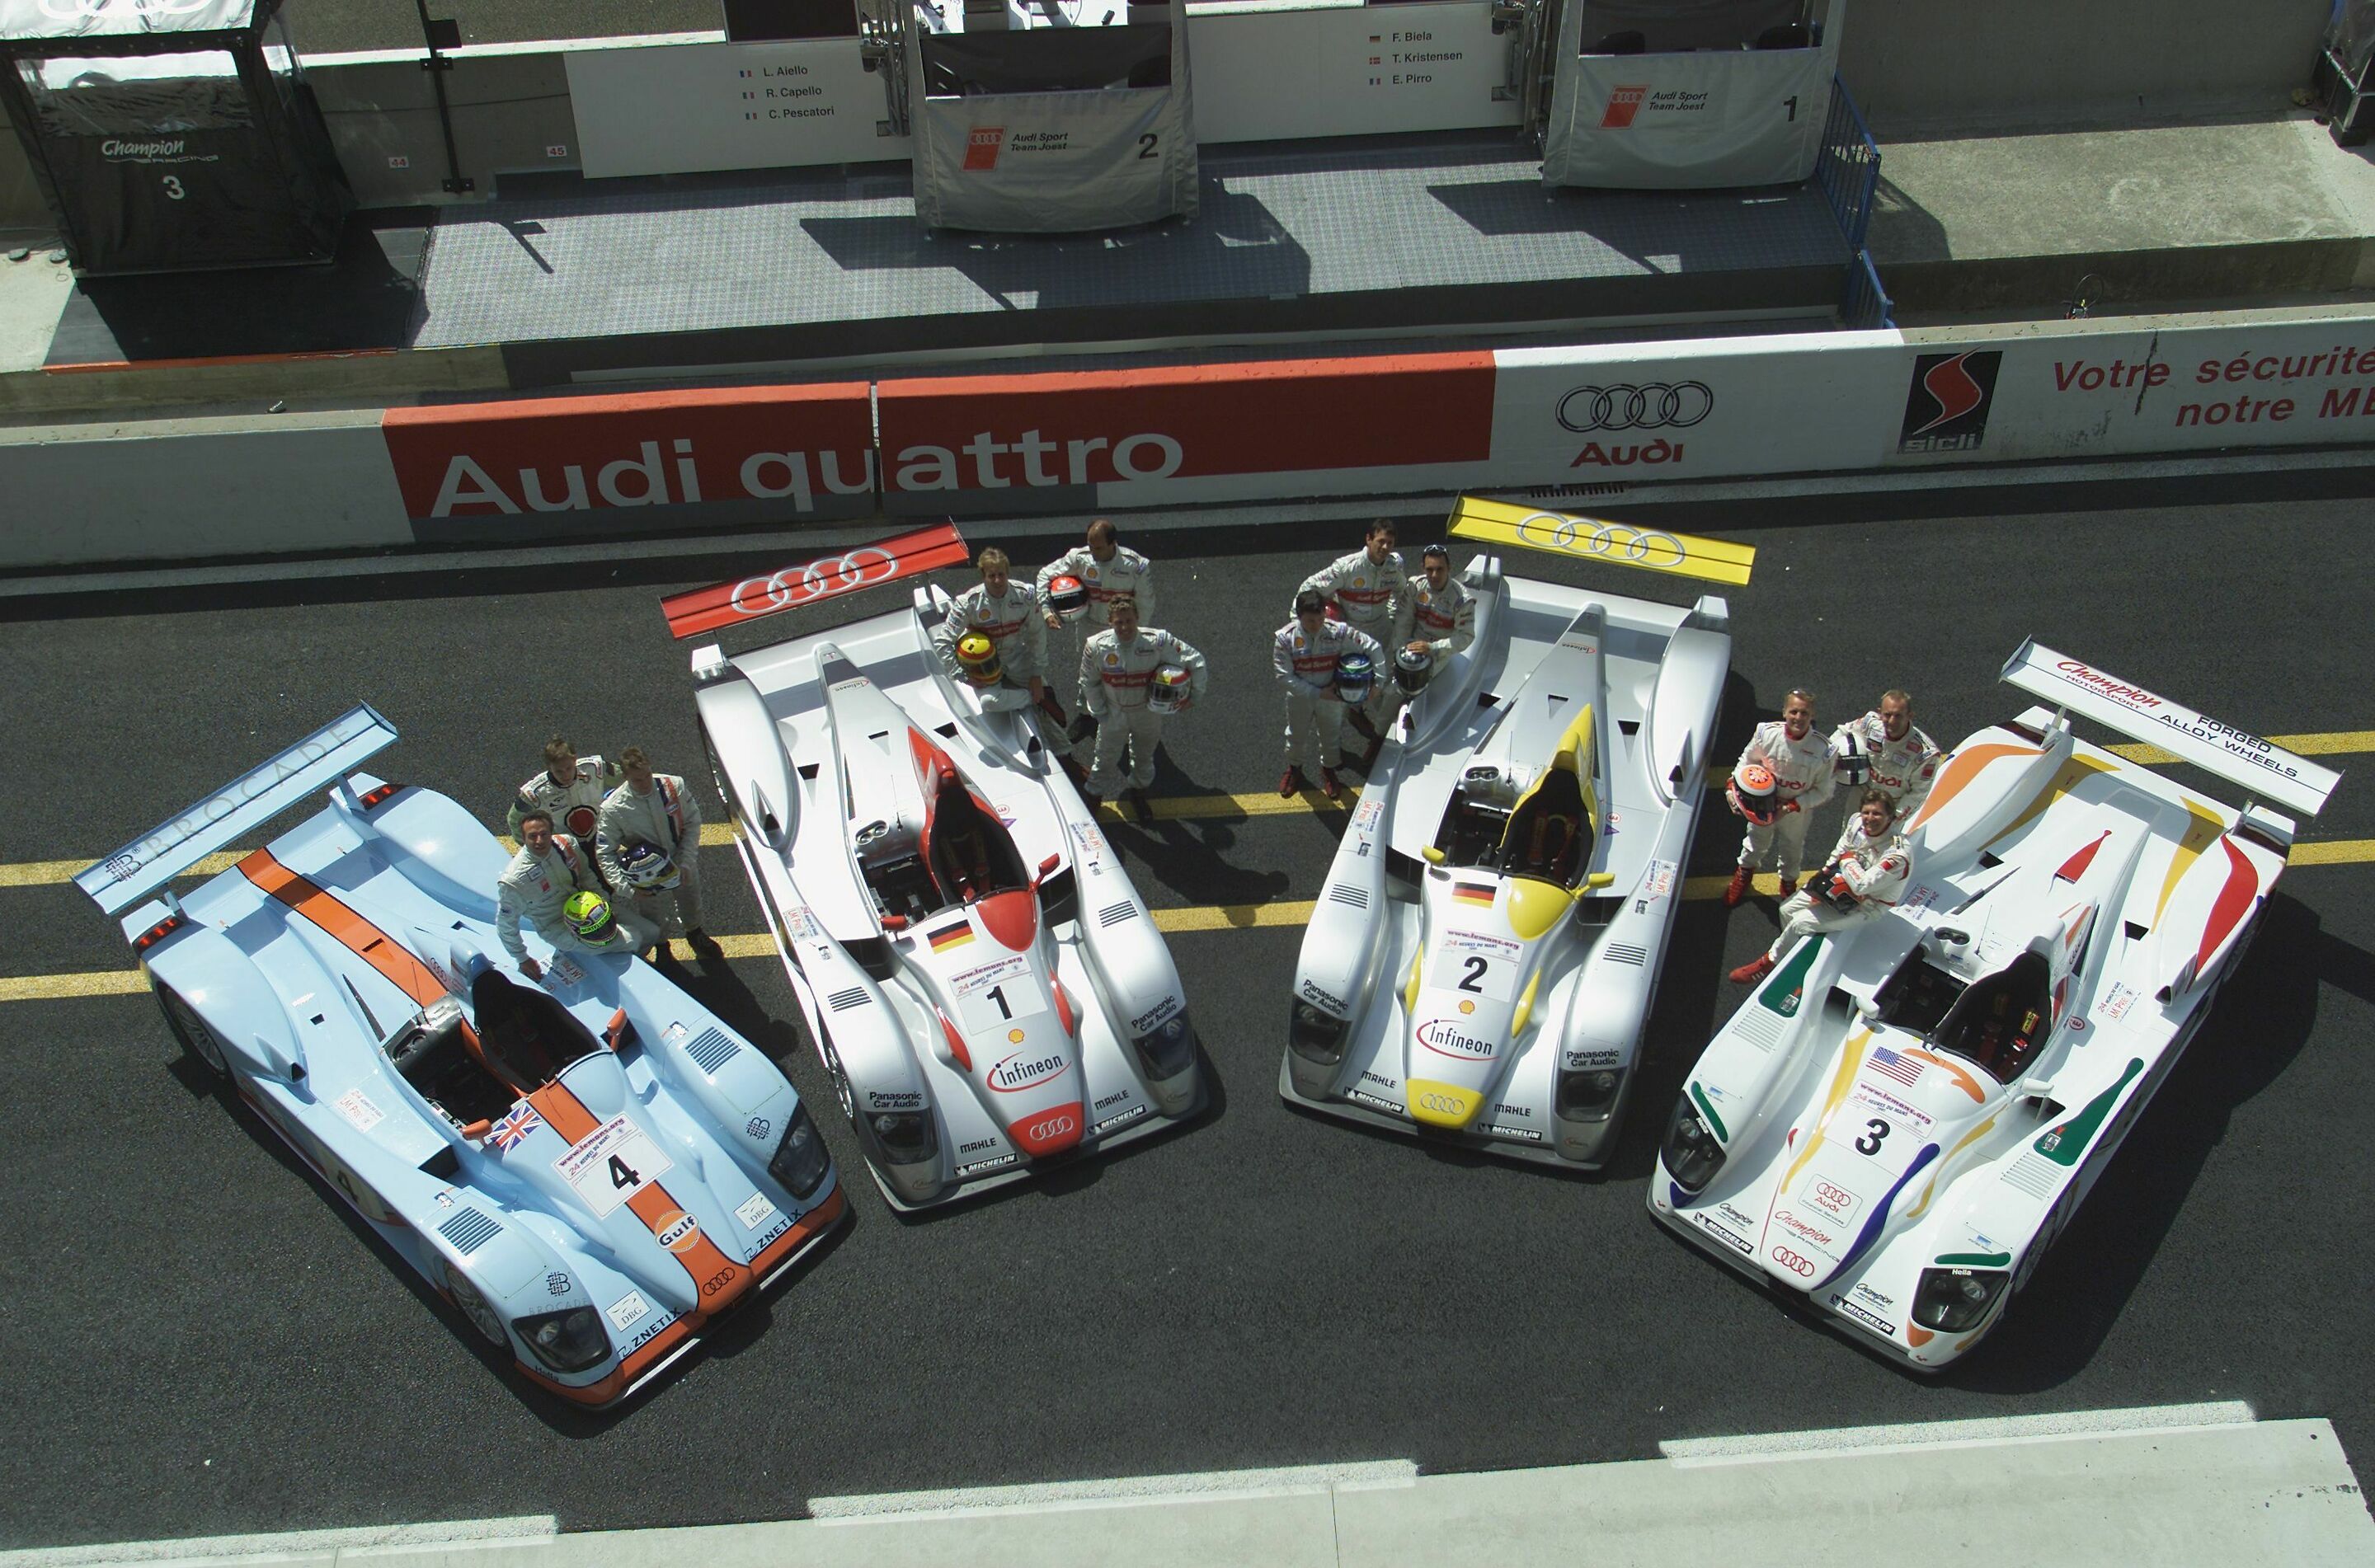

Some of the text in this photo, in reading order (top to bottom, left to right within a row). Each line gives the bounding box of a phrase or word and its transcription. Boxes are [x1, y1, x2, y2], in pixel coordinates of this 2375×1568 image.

[1392, 31, 1432, 42] F. Biela
[1392, 52, 1463, 63] T. Kristensen
[764, 66, 808, 77] L. Aiello
[1392, 73, 1432, 84] E. Pirro
[766, 86, 823, 98] R. Capello
[1652, 92, 1708, 101] Audi Sport
[769, 106, 835, 120] C. Pescatori
[1648, 101, 1705, 110] Team Joest
[1783, 96, 1798, 122] 1
[101, 140, 185, 157] Champion
[1010, 143, 1037, 152] Team
[1012, 133, 1069, 143] Audi Sport
[1138, 133, 1159, 159] 2
[391, 157, 408, 167] 44
[549, 147, 566, 157] 45
[163, 176, 186, 200] 3
[2053, 345, 2375, 392] Votre sécurité
[2175, 395, 2295, 427] notre
[1569, 439, 1684, 468] Audi
[1903, 433, 1979, 454] sicli
[430, 430, 1184, 519] Audi quattro
[2057, 661, 2162, 708] Champion
[2066, 674, 2142, 709] MOTORSPORT
[2160, 715, 2298, 777] ALLOY WHEELS
[2197, 716, 2271, 753] FORGED
[143, 723, 358, 861] BROCADE
[1458, 956, 1488, 994] 2
[986, 985, 1013, 1020] 1
[1302, 988, 1343, 1016] Car Audio
[1303, 979, 1349, 1011] Panasonic
[1131, 995, 1175, 1029] Panasonic
[1140, 1003, 1178, 1032] Car Audio
[1567, 1049, 1619, 1060] Panasonic
[1571, 1058, 1616, 1067] Car Audio
[1361, 1071, 1398, 1090] MAHLE
[869, 1091, 923, 1101] Panasonic
[873, 1099, 920, 1109] Car Audio
[1094, 1089, 1130, 1111] MAHLE
[1356, 1092, 1403, 1112] MICHELIN
[1860, 1082, 1932, 1124] www.lemans.org
[1101, 1105, 1145, 1129] MICHELIN
[1494, 1104, 1531, 1117] MAHLE
[1491, 1125, 1541, 1140] MICHELIN
[1855, 1119, 1891, 1156] 3
[960, 1137, 997, 1153] MAHLE
[608, 1154, 642, 1190] 4
[968, 1154, 1016, 1172] MICHELIN
[750, 1205, 769, 1223] DBG
[1719, 1202, 1755, 1226] Champion
[1814, 1196, 1840, 1214] Audi
[659, 1217, 696, 1247] Gulf
[756, 1208, 802, 1249] ZNETIX
[1706, 1221, 1752, 1251] MICHELIN
[1775, 1210, 1832, 1246] Champion
[1951, 1268, 1973, 1276] Hella
[1855, 1283, 1894, 1306] Champion
[621, 1306, 642, 1325] DBG
[1844, 1303, 1894, 1333] MICHELIN
[632, 1307, 682, 1348] ZNETIX
